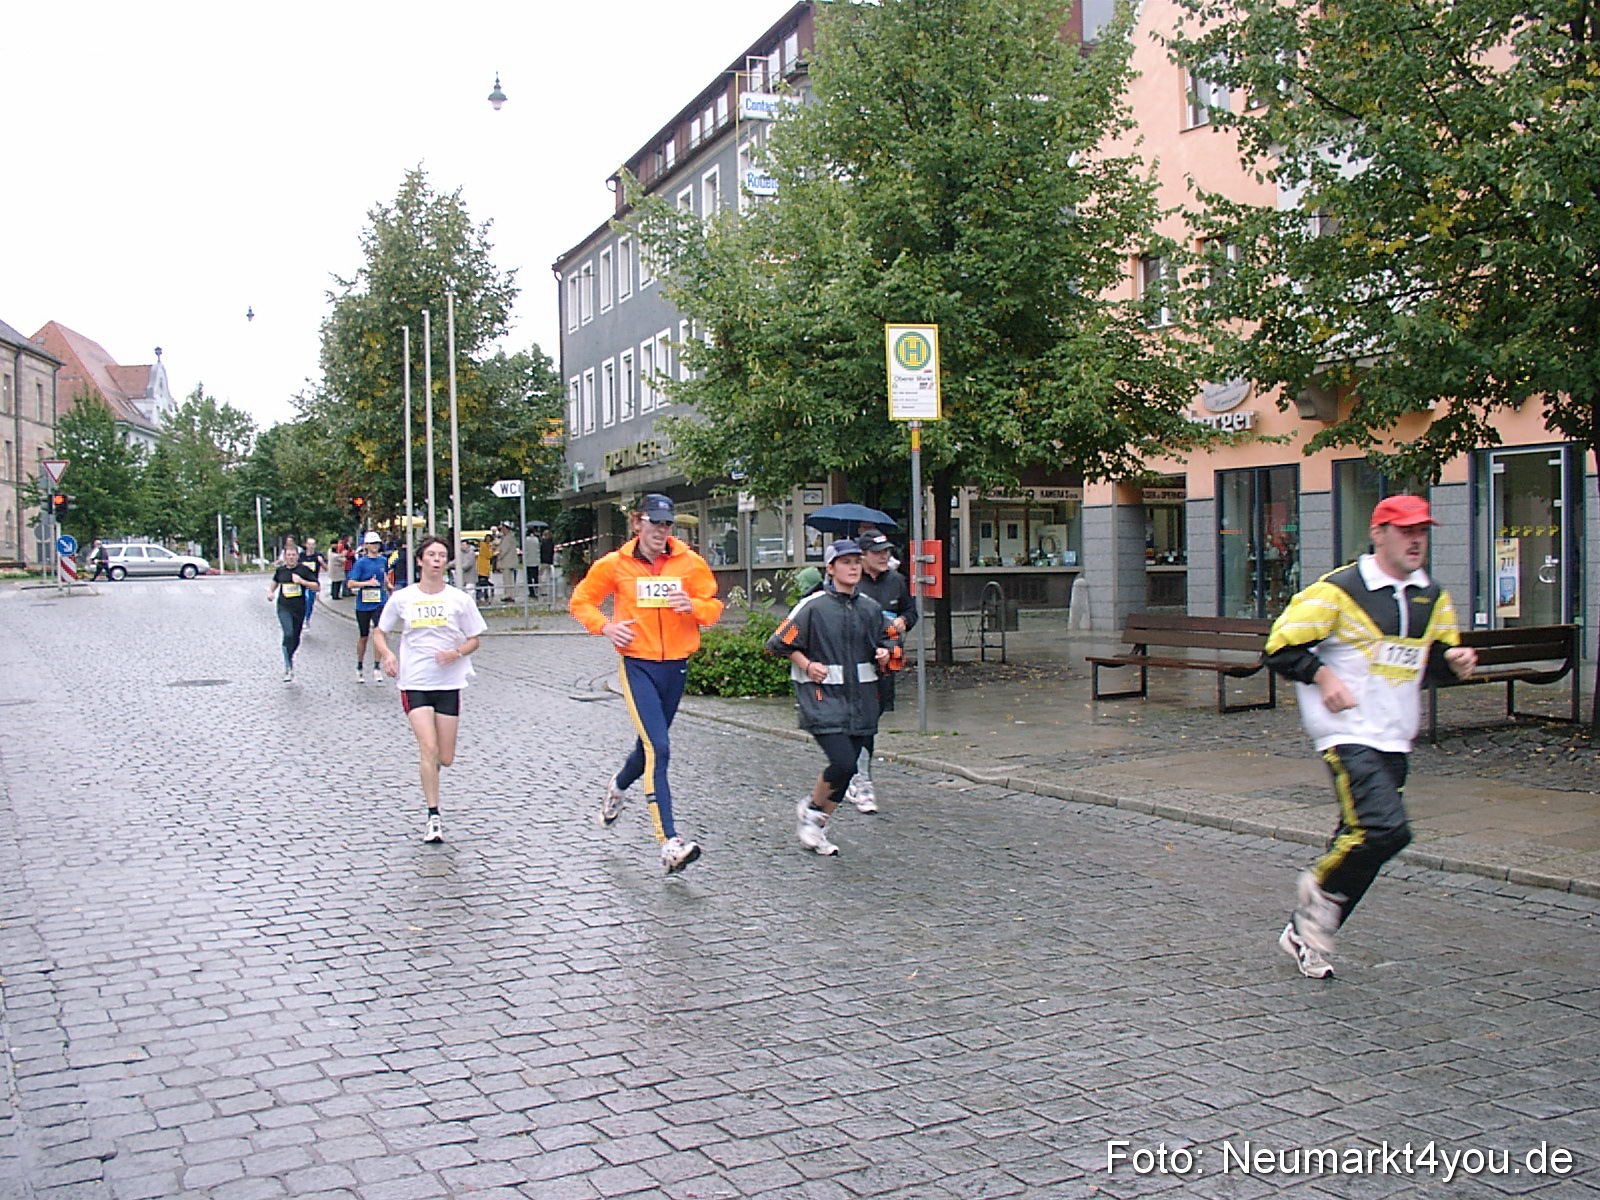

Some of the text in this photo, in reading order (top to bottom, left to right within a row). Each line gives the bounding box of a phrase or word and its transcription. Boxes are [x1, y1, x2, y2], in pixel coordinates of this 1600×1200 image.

[905, 341, 922, 362] H
[500, 483, 517, 495] WC
[417, 605, 444, 618] 1302
